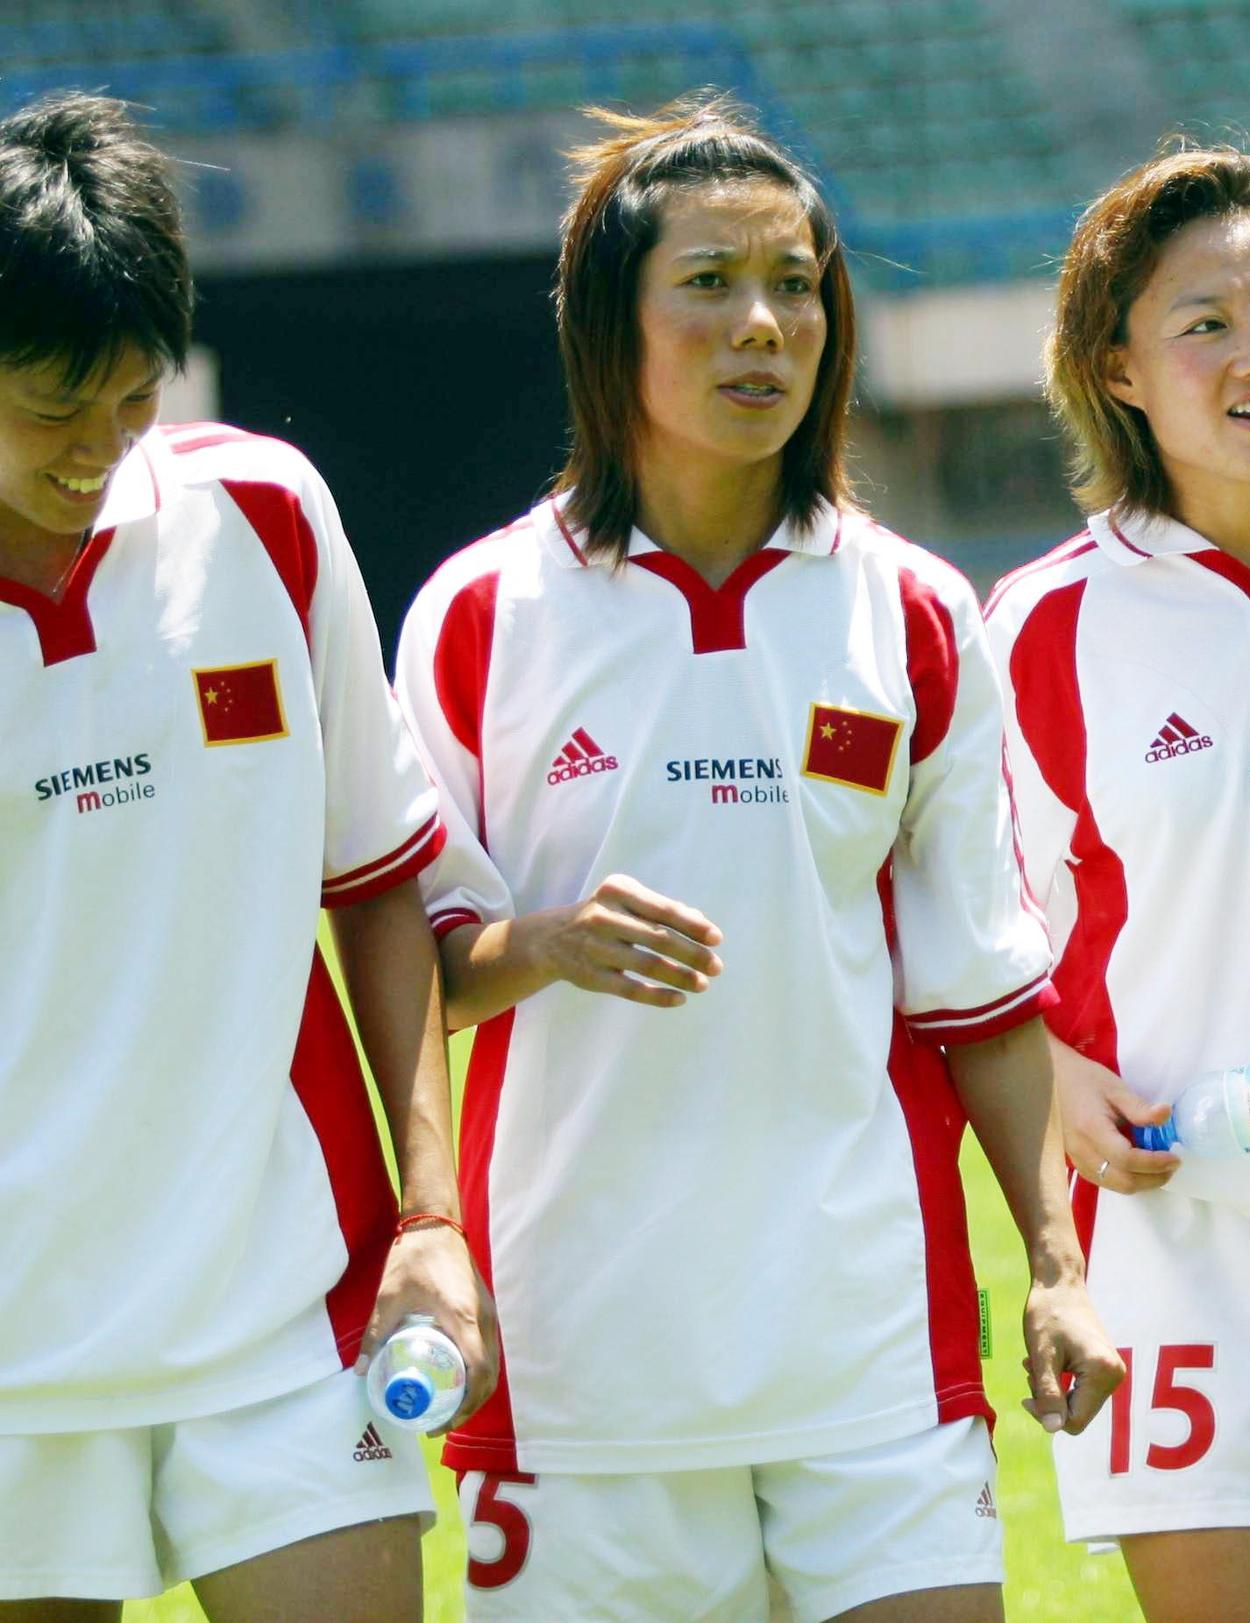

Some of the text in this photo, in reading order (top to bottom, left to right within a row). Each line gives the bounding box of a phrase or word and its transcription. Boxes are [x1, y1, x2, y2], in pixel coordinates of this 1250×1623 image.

[1145, 733, 1213, 764] adidas
[34, 753, 152, 801] SIEMENS
[547, 756, 619, 786] adidas
[666, 758, 783, 782] SIEMENS
[76, 782, 156, 814] mobile
[1109, 1344, 1217, 1477] 15
